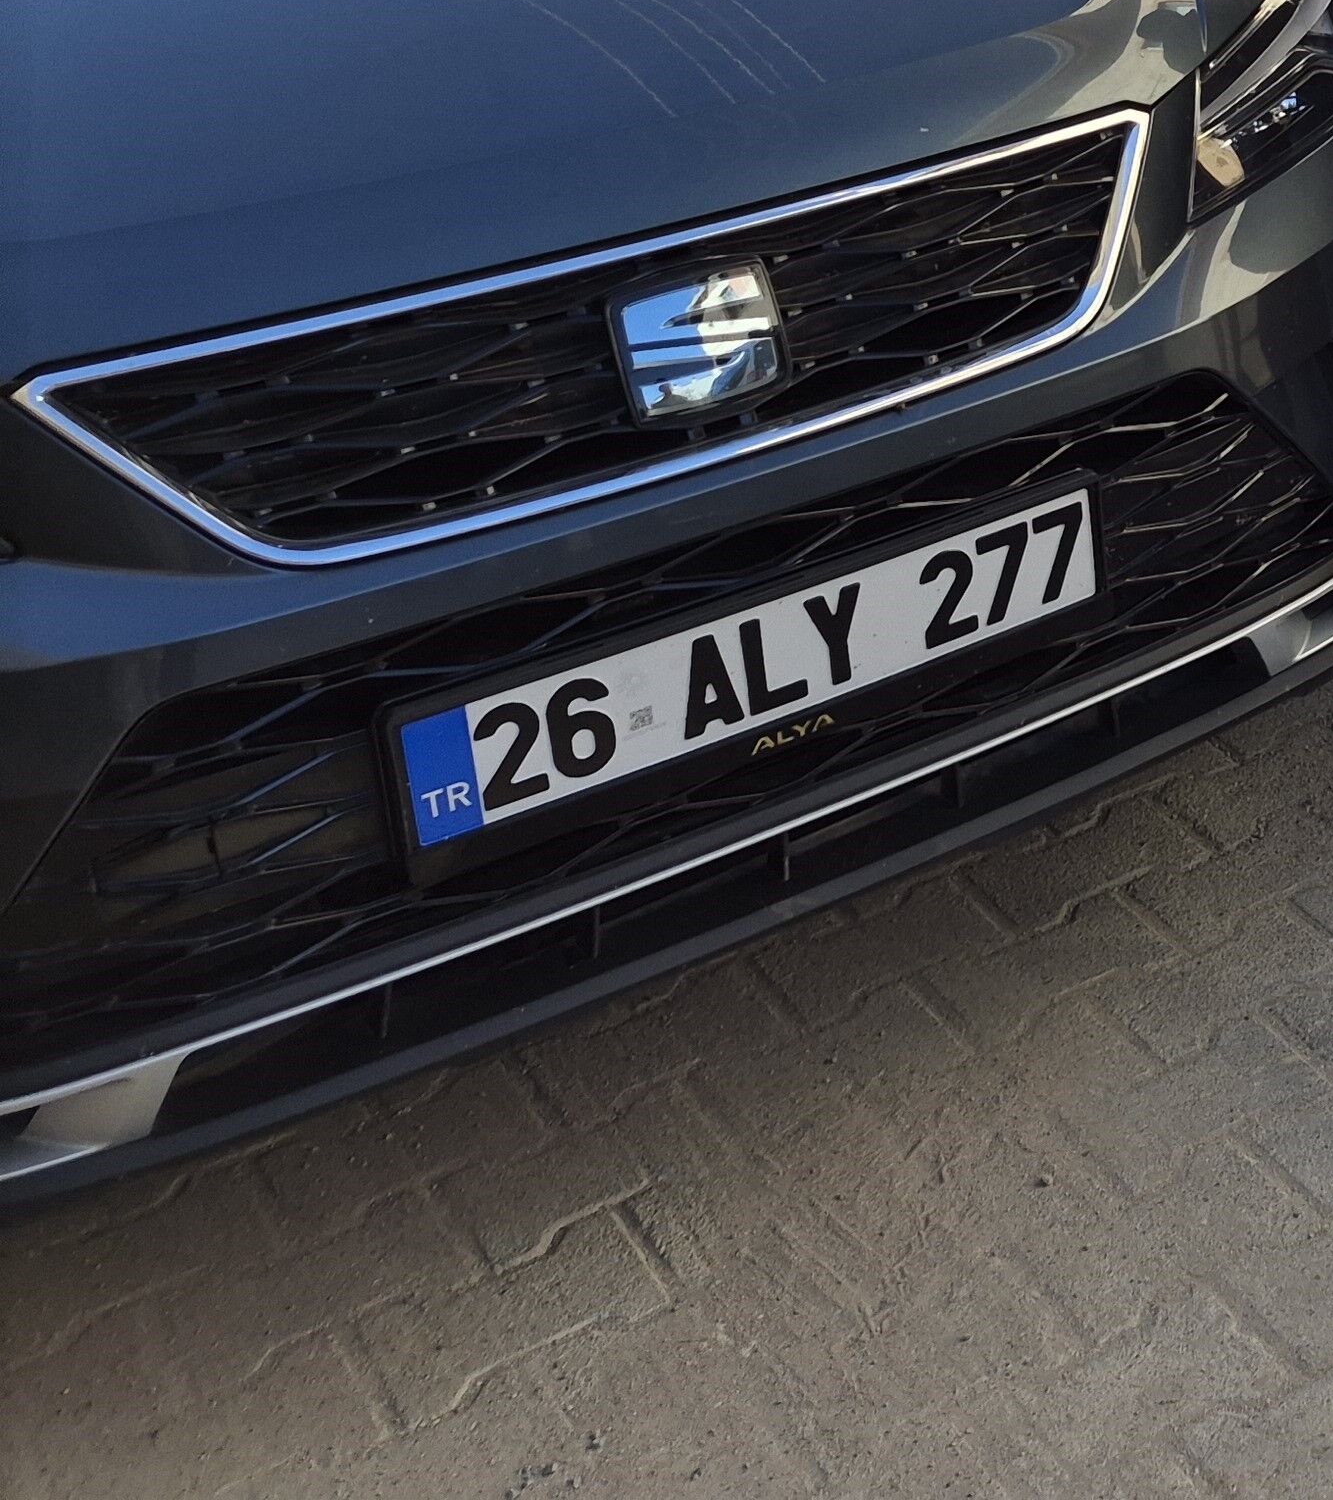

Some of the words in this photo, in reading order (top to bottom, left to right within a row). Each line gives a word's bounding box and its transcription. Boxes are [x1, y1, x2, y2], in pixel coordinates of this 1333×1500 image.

[473, 677, 618, 812] 26
[684, 582, 861, 741] ALY
[918, 502, 1083, 650] 277
[751, 713, 836, 756] ALYA
[421, 780, 472, 820] TR
